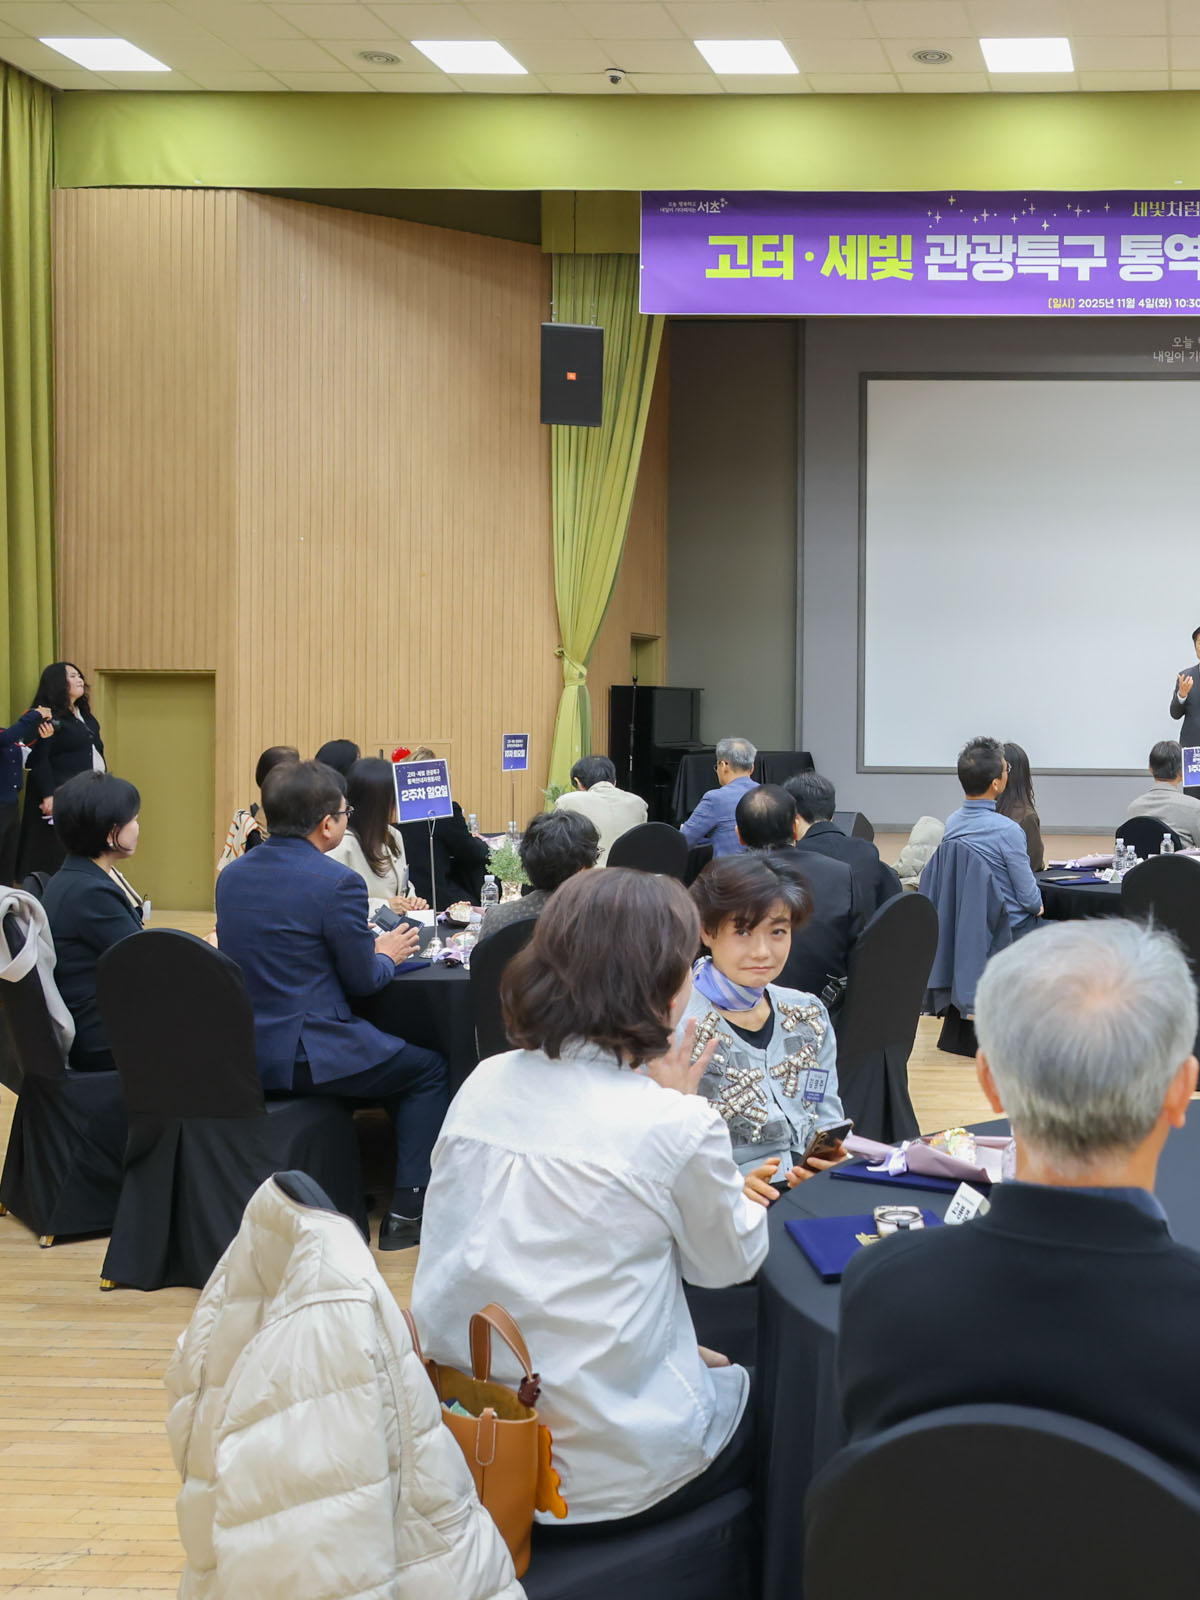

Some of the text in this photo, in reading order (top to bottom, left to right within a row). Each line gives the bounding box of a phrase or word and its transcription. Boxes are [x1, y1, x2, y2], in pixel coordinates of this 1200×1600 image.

[697, 201, 720, 213] 서초
[1131, 200, 1200, 217] 세빛처럼
[924, 233, 1108, 281] 관광특구
[1048, 298, 1075, 309] [일시]
[1078, 298, 1115, 309] 2025년
[1117, 298, 1136, 309] 11월
[1138, 298, 1172, 309] 4일(화)
[1171, 336, 1194, 349] 오늘
[1153, 351, 1185, 363] 내일이
[401, 784, 449, 802] 2주차 일요일
